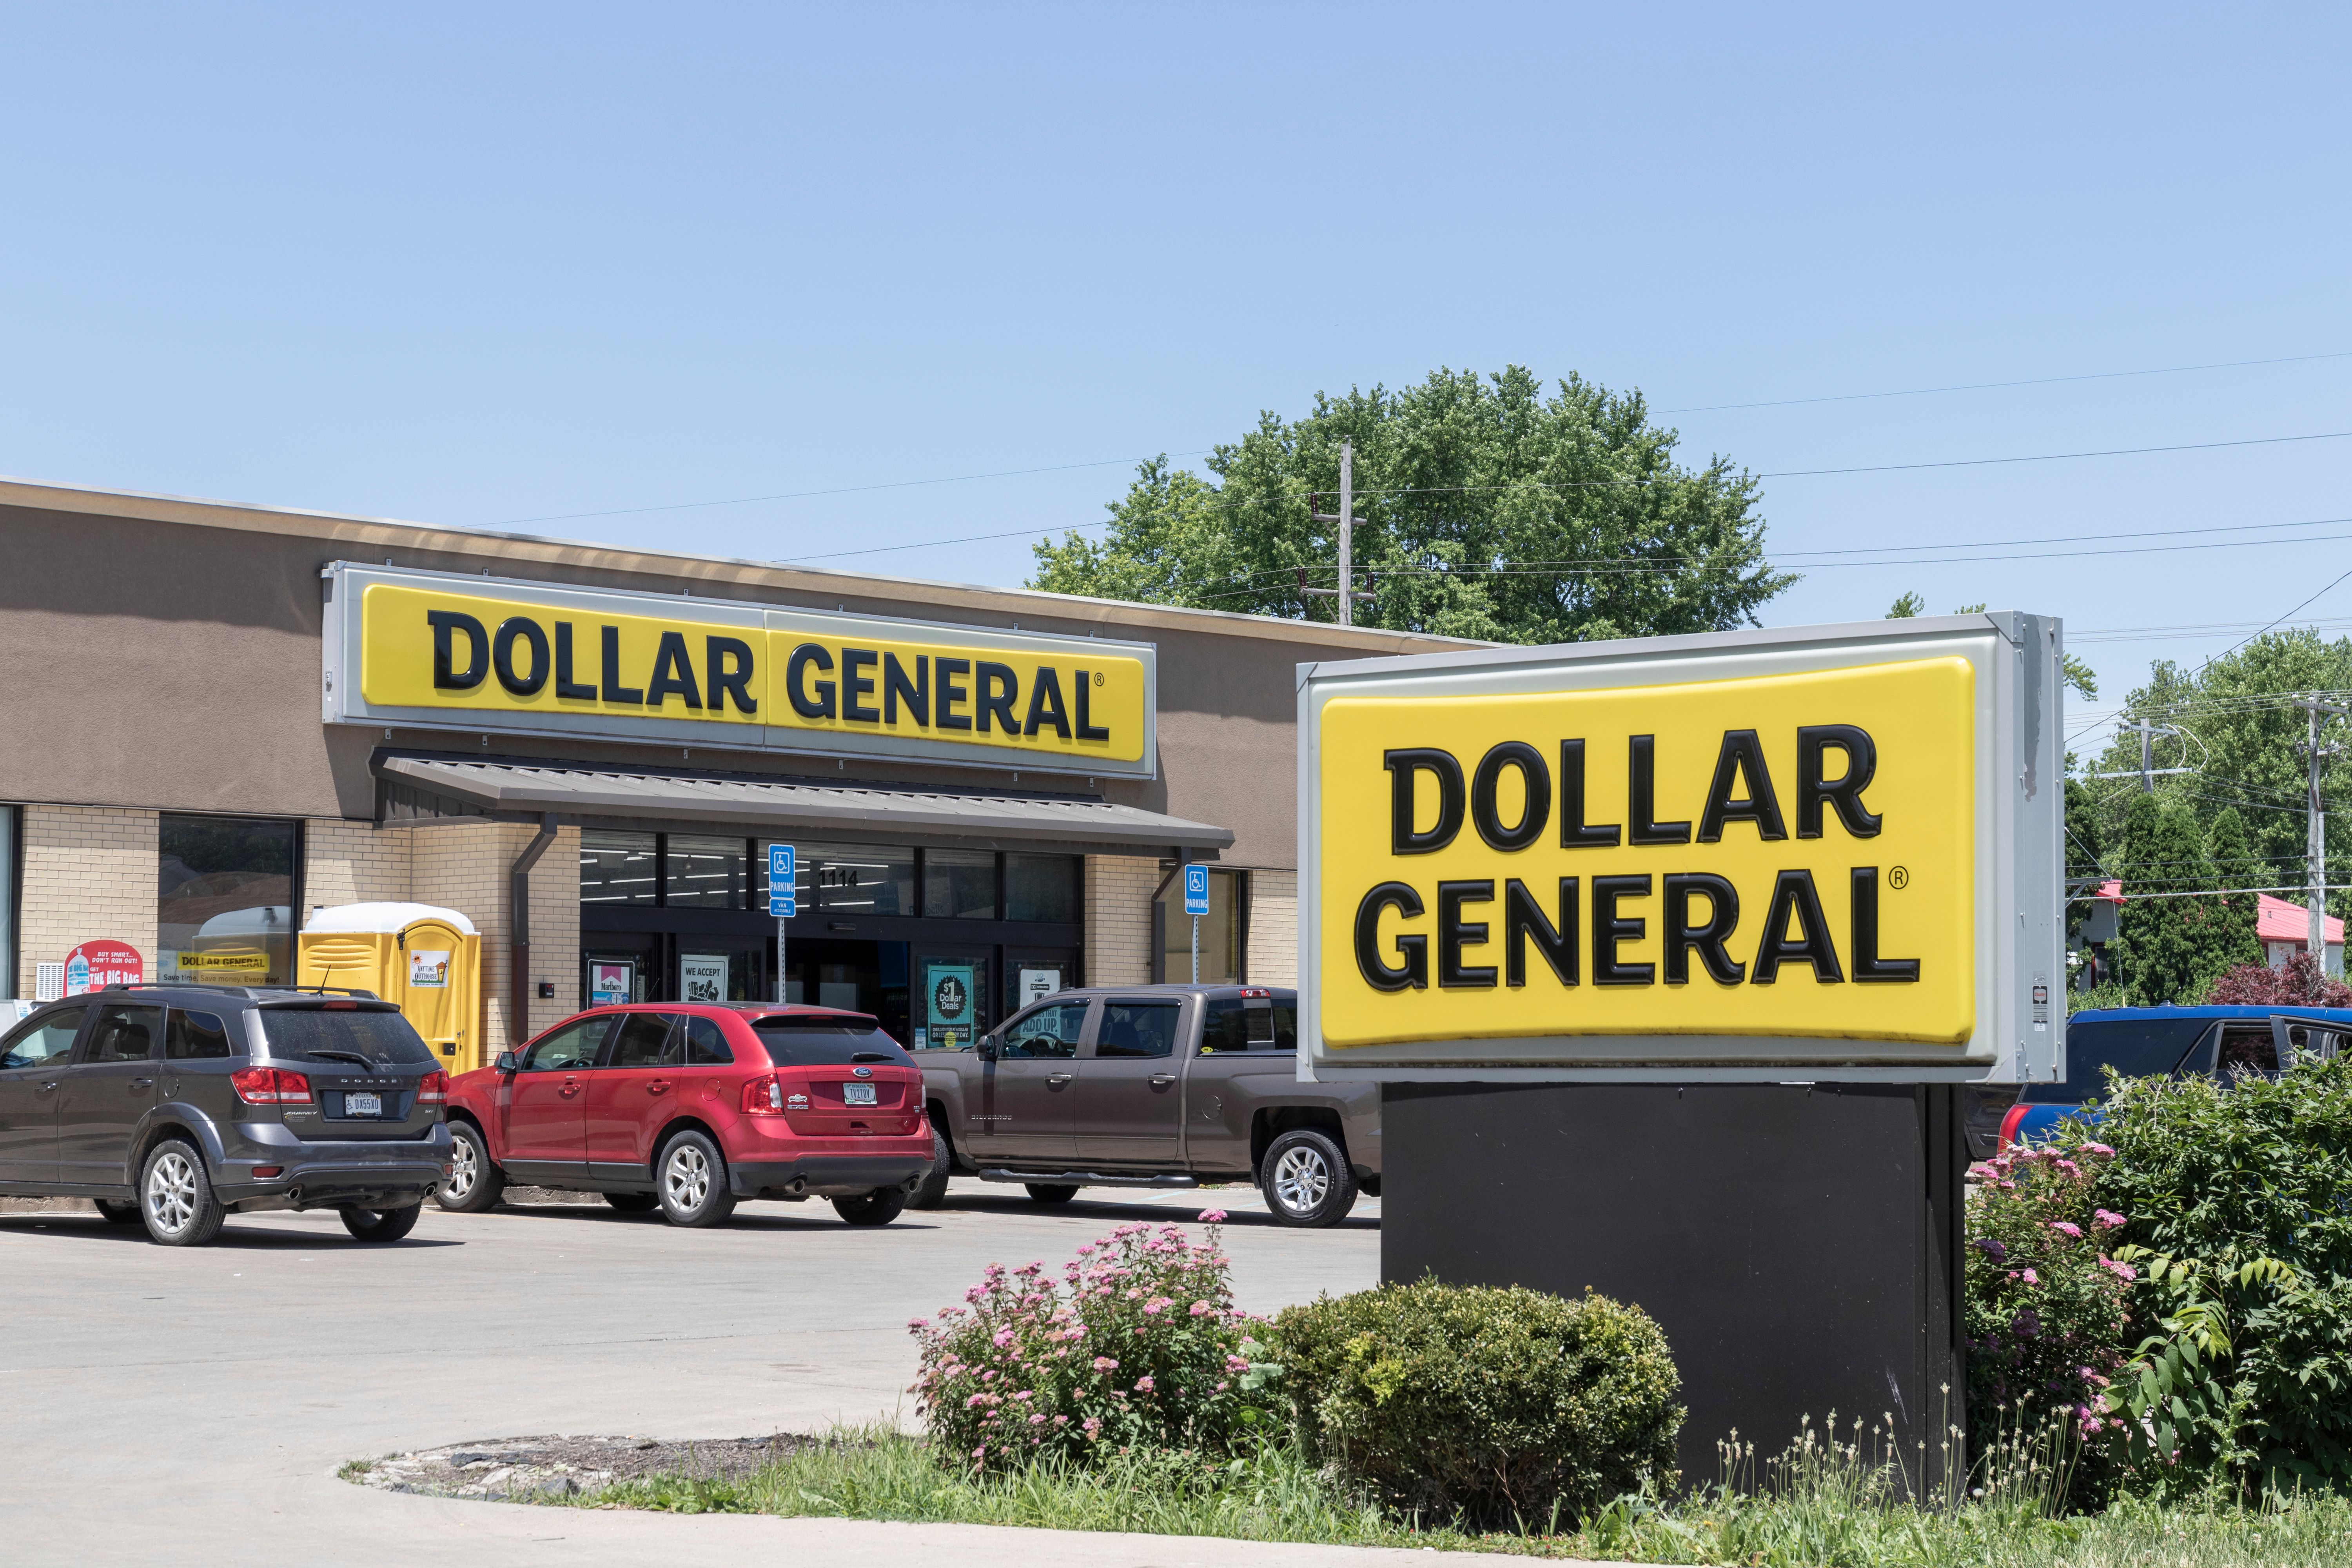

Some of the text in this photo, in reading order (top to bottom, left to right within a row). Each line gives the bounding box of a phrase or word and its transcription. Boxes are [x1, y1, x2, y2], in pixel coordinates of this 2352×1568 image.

[427, 609, 758, 715] DOLLAR
[786, 642, 1110, 742] GENERAL
[1383, 724, 1883, 856] DOLLAR
[818, 869, 858, 887] 1114
[770, 881, 794, 892] PARKING
[1186, 898, 1207, 908] PARKING
[1353, 866, 1921, 993] GENERAL
[182, 956, 265, 967] DOLLAR GENERAL
[89, 970, 140, 985] THE BIG BAG
[686, 967, 720, 976] WE ACCEPT
[601, 981, 621, 991] Marlboro
[1022, 1018, 1058, 1033] ADD UP.
